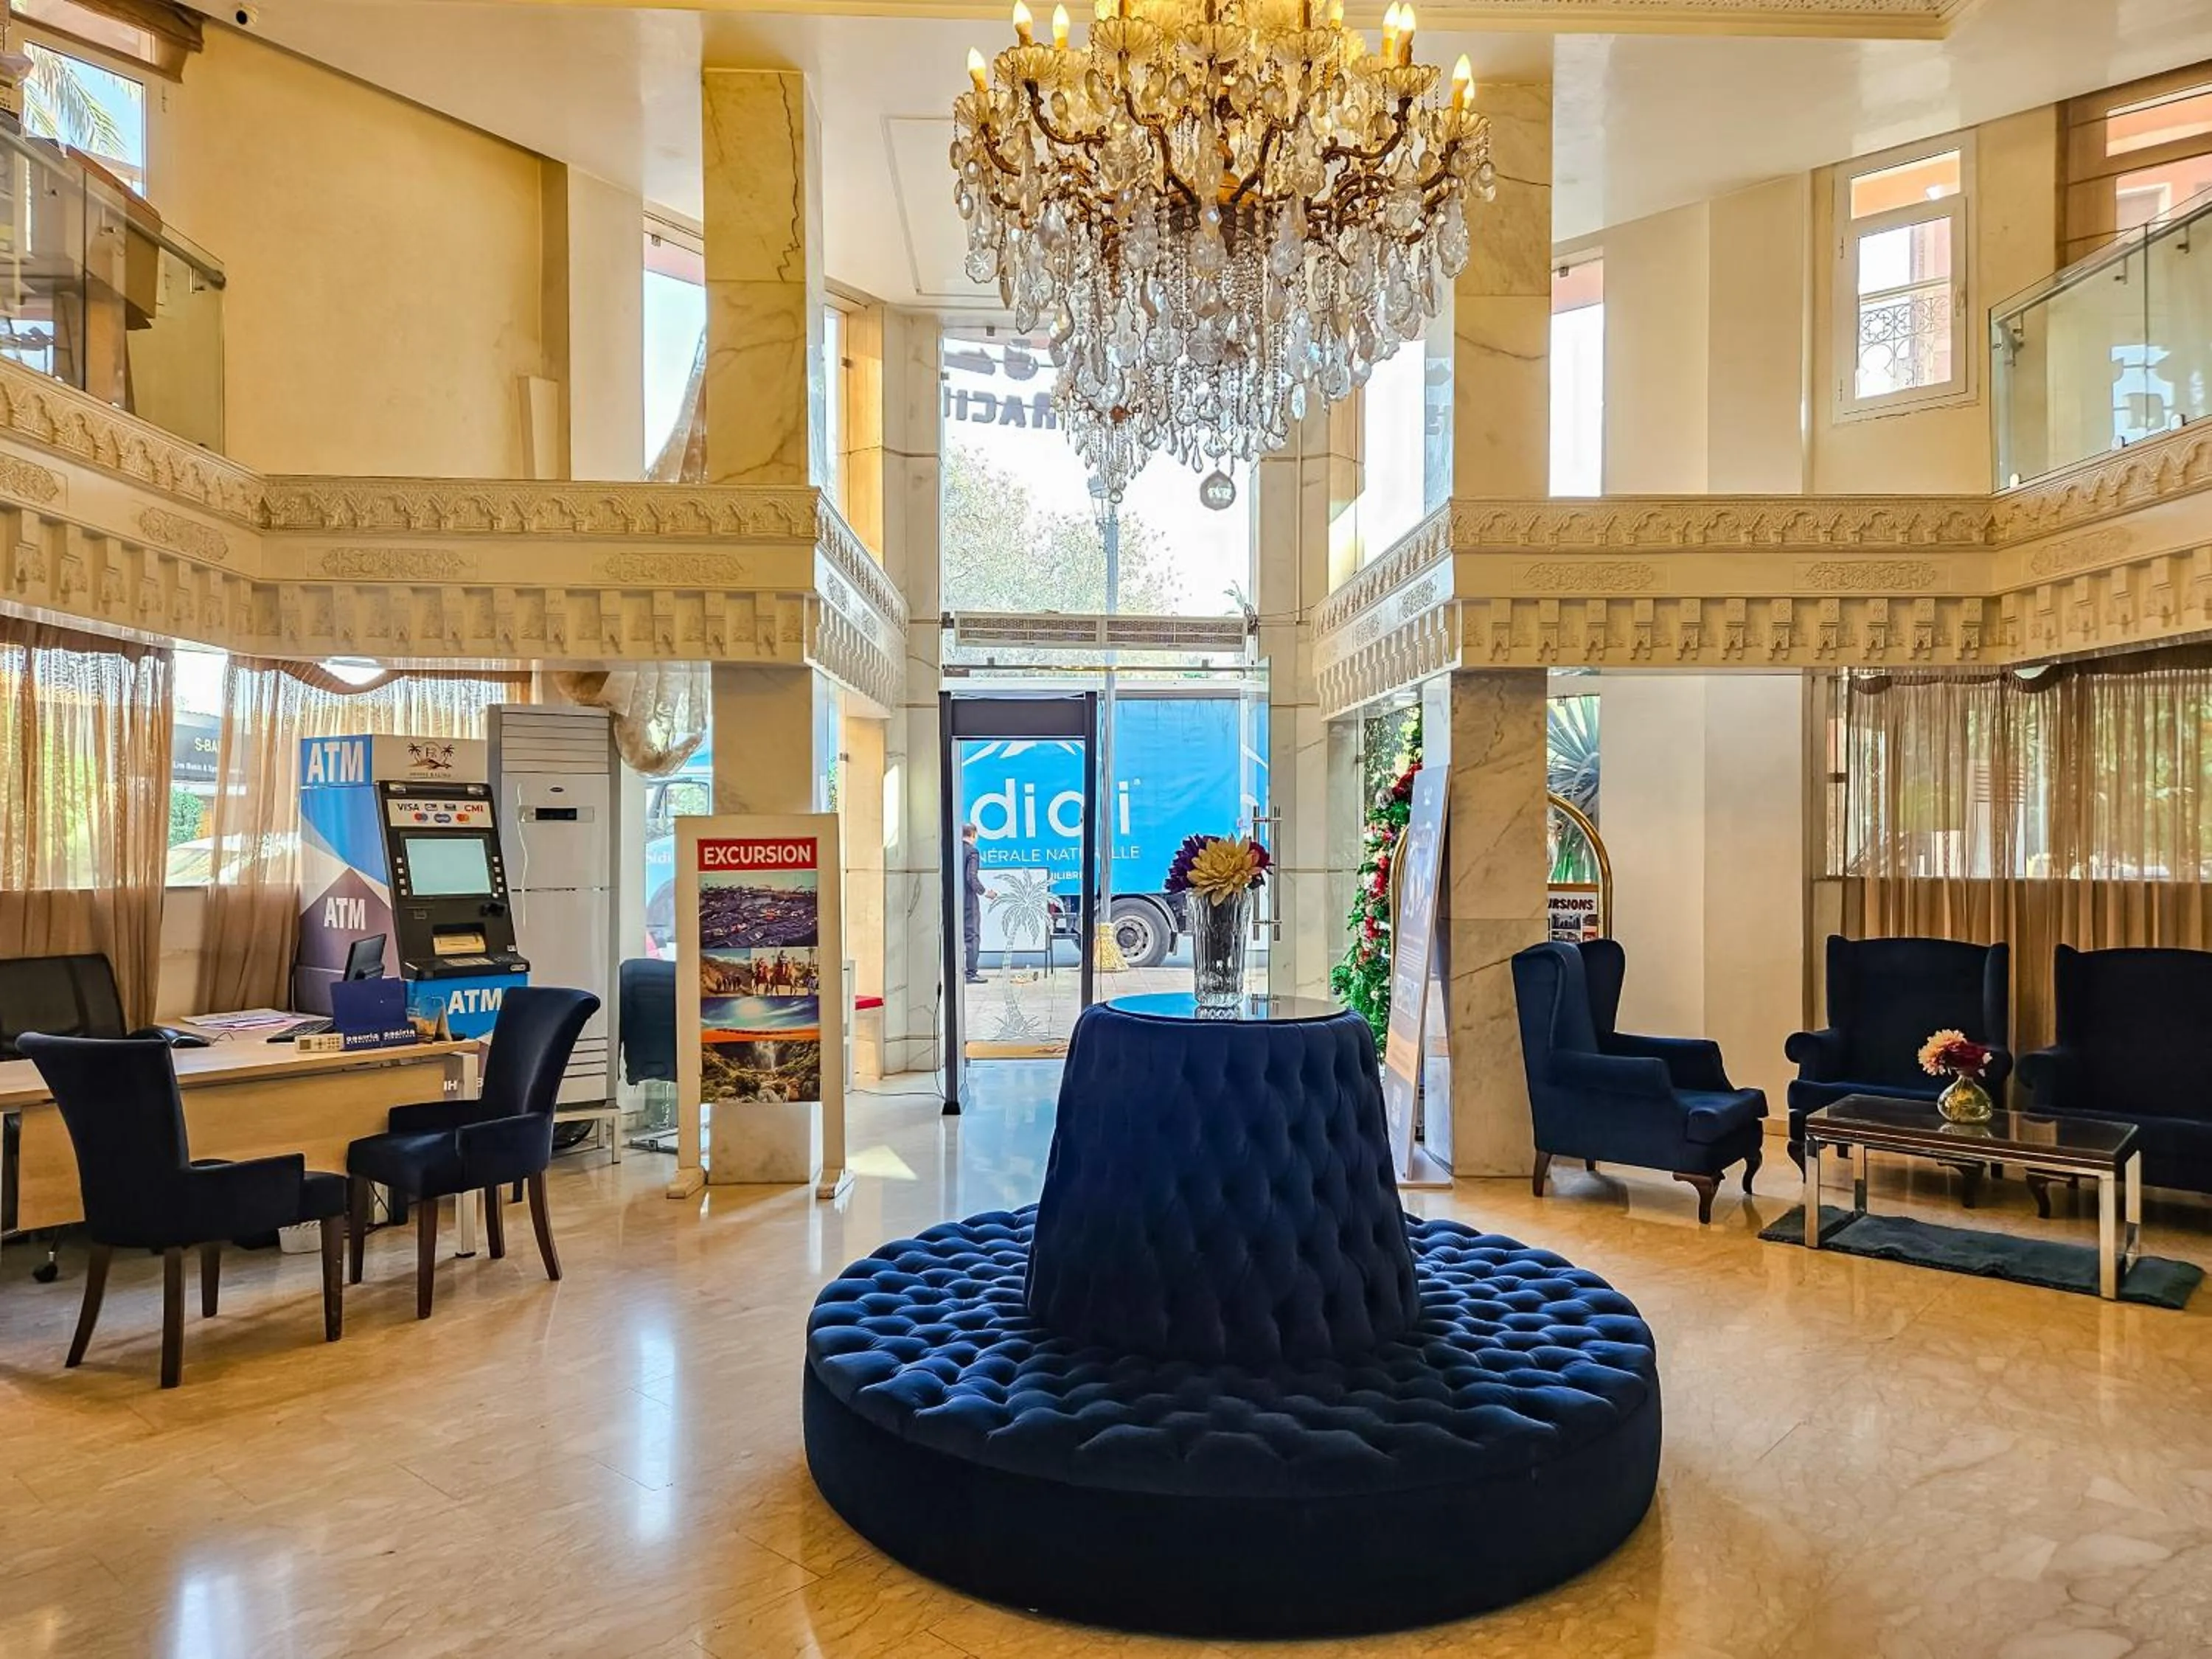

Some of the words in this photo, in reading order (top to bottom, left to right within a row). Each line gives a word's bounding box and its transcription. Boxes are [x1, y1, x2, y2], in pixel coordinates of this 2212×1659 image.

[307, 740, 364, 782] ATM
[397, 803, 420, 811] VISA
[970, 779, 1036, 840] di
[704, 845, 811, 865] EXCURSION
[979, 847, 1041, 863] NÉRALE
[324, 897, 366, 931] ATM
[448, 988, 502, 1015] ATM
[443, 1080, 457, 1091] IH
